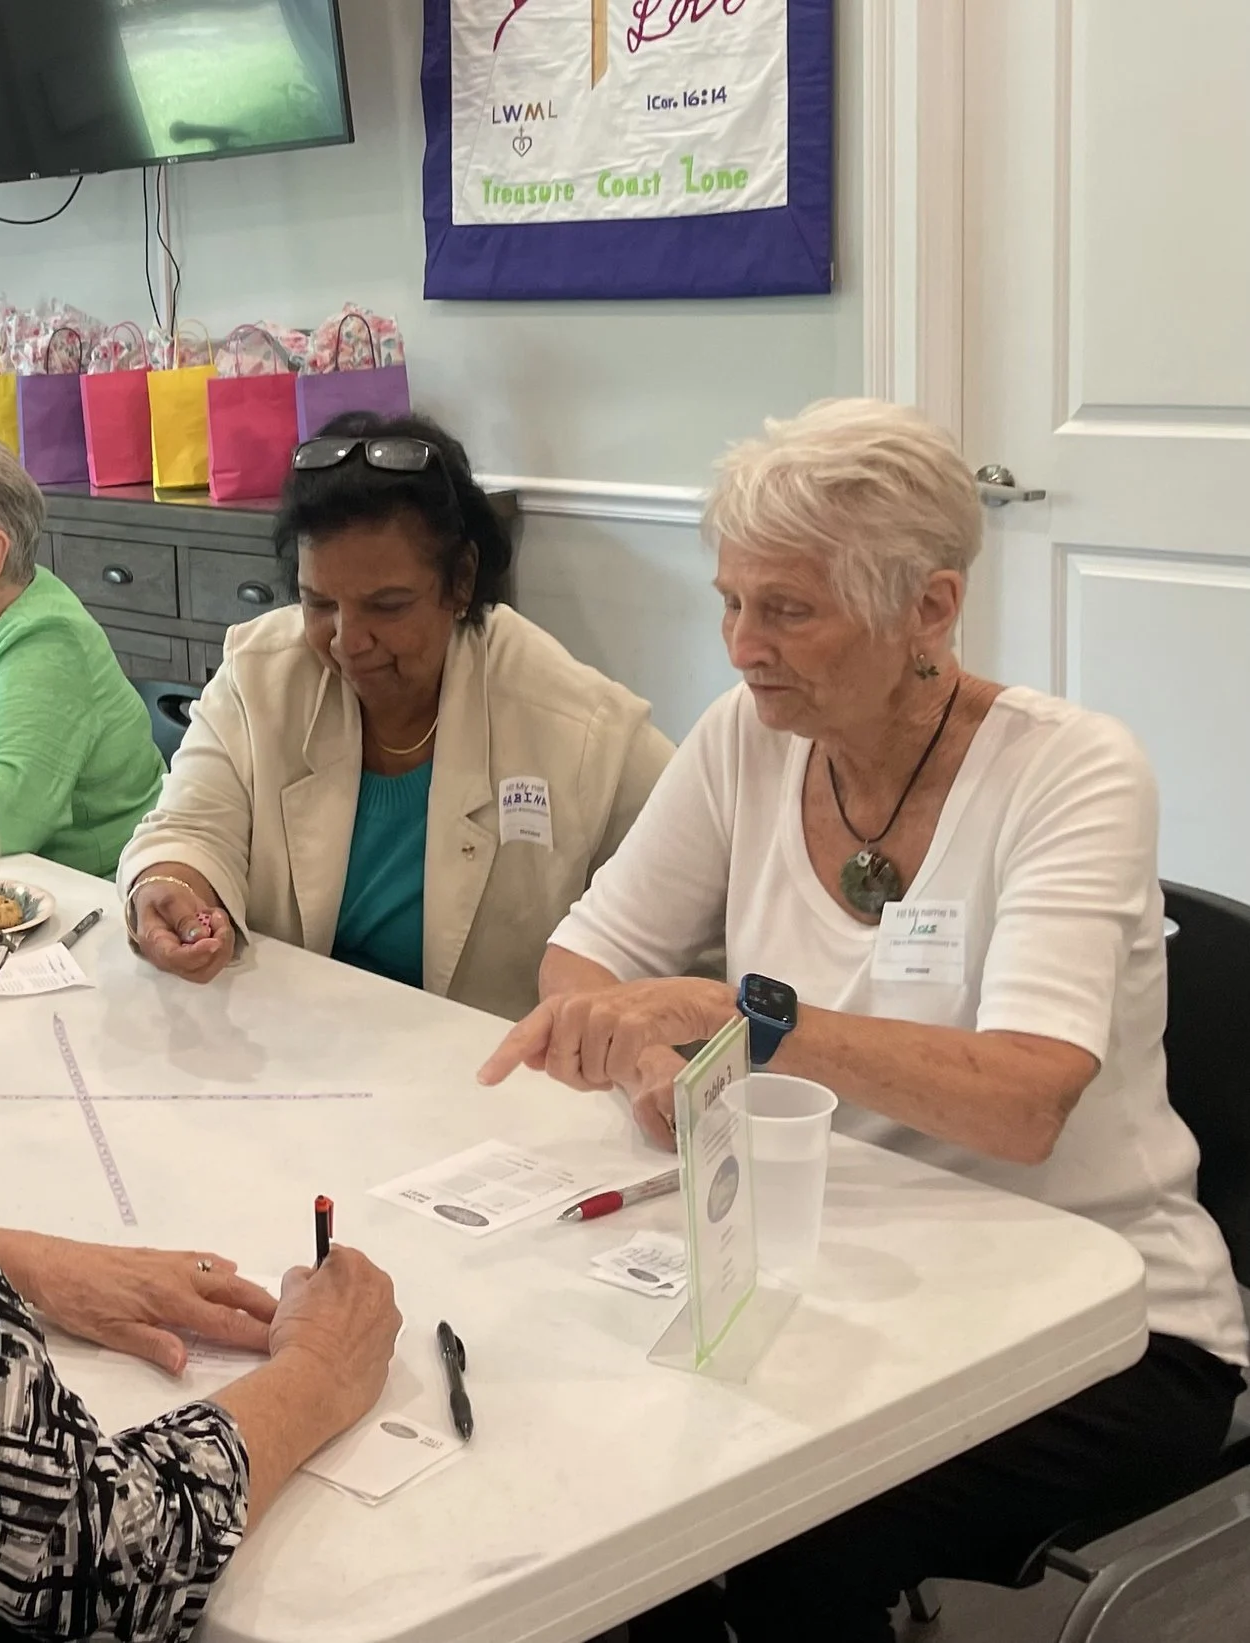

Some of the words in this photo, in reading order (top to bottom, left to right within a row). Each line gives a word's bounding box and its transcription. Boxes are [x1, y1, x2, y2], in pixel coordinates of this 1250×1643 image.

[492, 99, 558, 125] LWML
[683, 85, 727, 108] 16:14
[482, 177, 575, 205] Treasure
[597, 169, 661, 197] Coast
[680, 154, 748, 193] Zone
[703, 1075, 726, 1112] Table
[726, 1063, 733, 1085] 3
